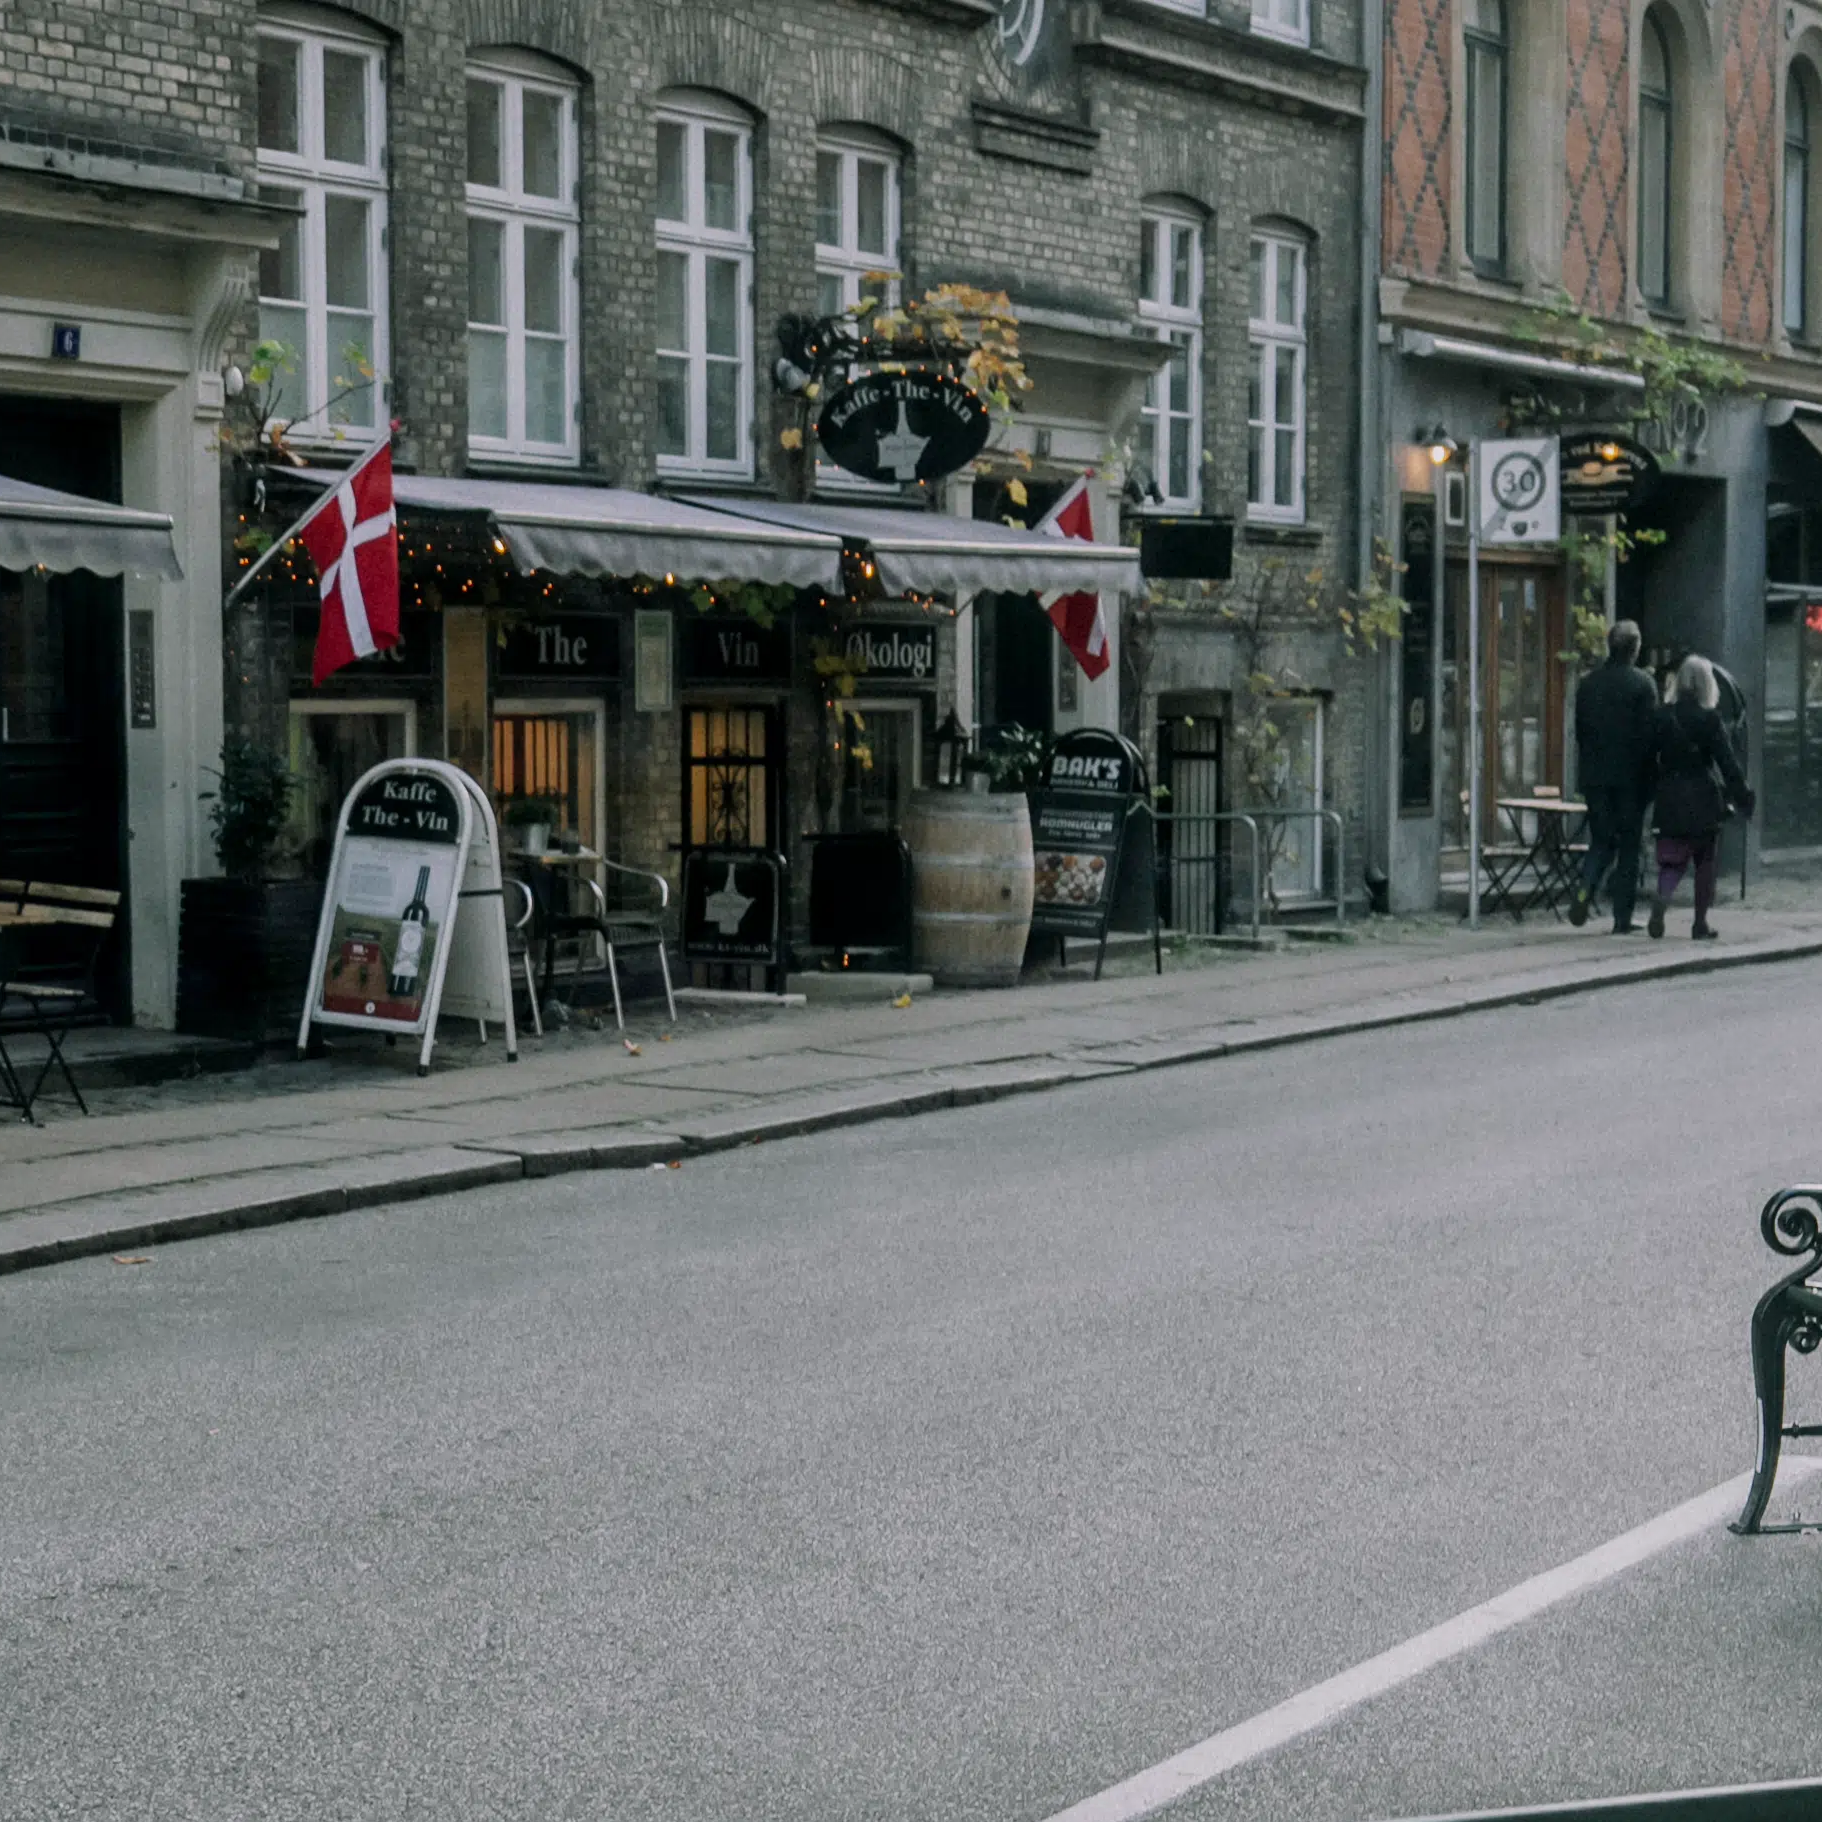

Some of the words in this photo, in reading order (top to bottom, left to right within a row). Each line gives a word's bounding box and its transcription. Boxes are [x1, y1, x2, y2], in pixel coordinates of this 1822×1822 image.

[64, 331, 74, 352] 6
[830, 384, 880, 429] Kaffe
[891, 379, 930, 400] The
[942, 387, 973, 424] Vin
[1502, 469, 1535, 494] 30
[535, 624, 588, 665] The
[718, 631, 760, 667] Vin
[383, 781, 437, 803] Kaffe
[362, 805, 399, 826] The
[416, 810, 449, 831] Vin
